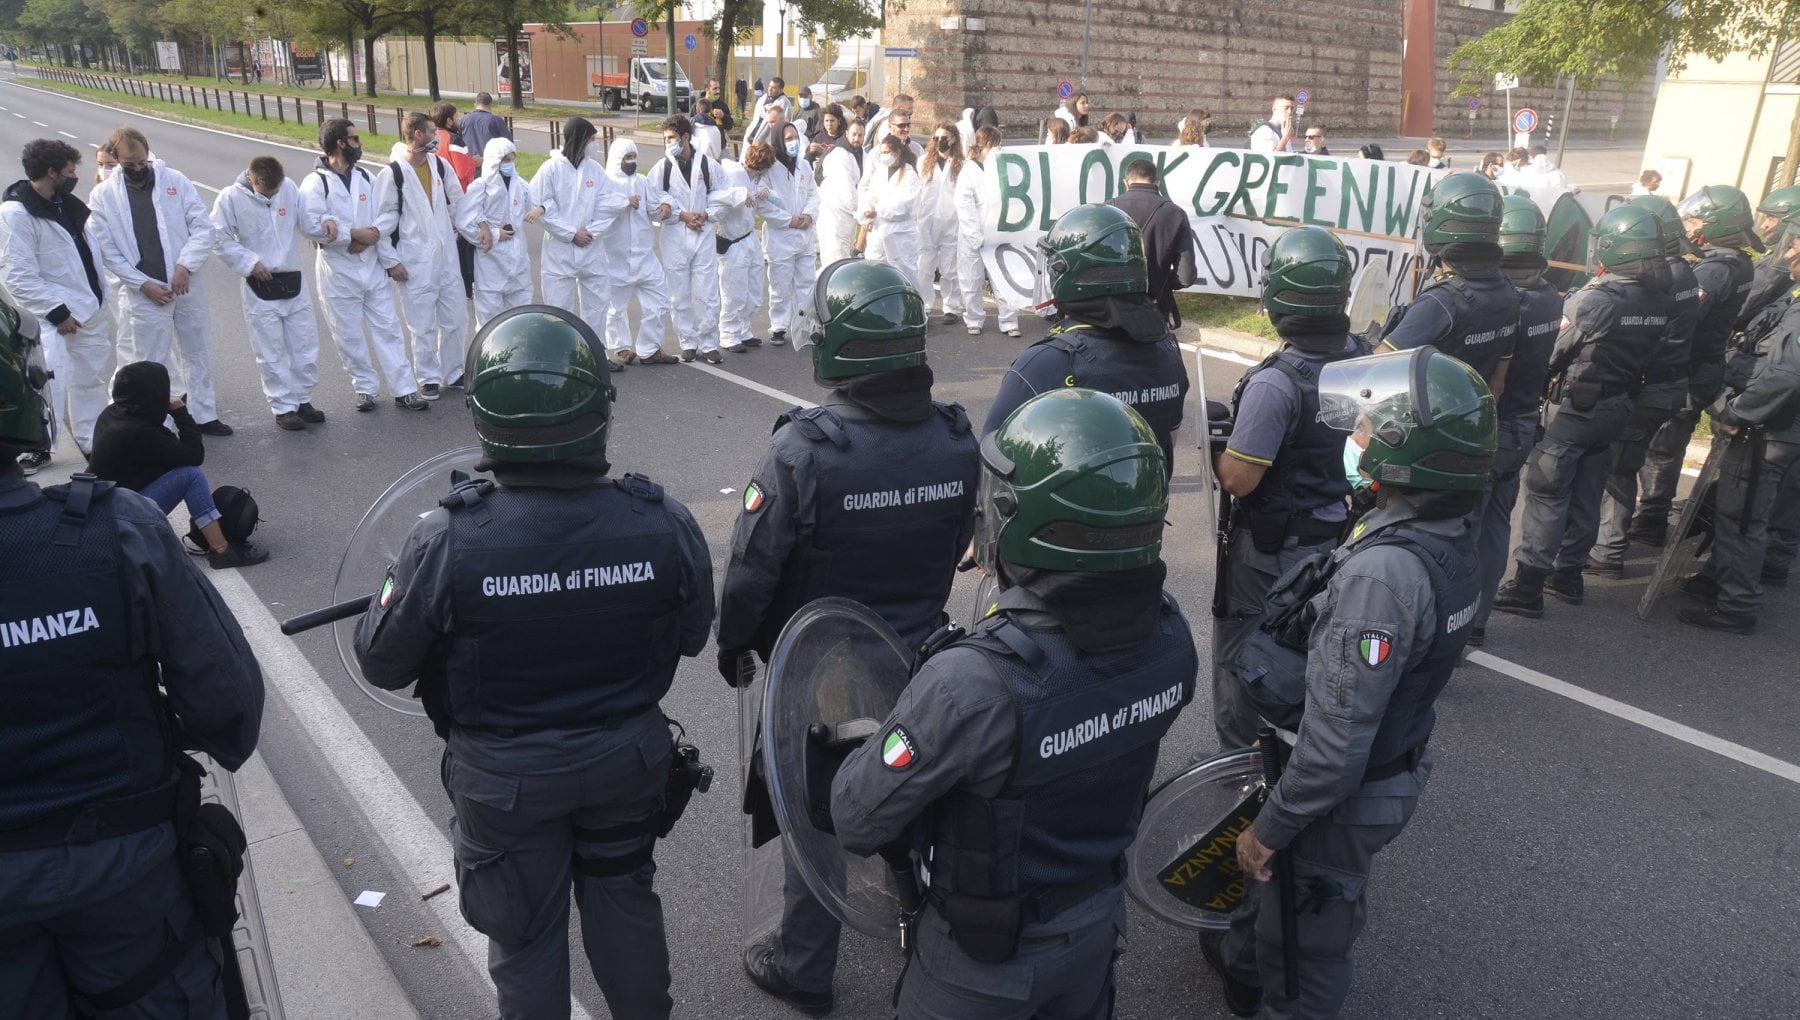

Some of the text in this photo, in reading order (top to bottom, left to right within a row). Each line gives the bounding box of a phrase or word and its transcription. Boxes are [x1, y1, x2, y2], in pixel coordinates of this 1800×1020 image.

[1192, 151, 1432, 240] GREENW
[1141, 389, 1150, 403] di
[1150, 383, 1180, 402] FINANZA
[843, 480, 964, 511] GUARDIA di FINANZA
[482, 561, 655, 597] GUARDIA di FINANZA
[0, 606, 100, 647] INANZA
[1363, 633, 1388, 643] ITALIA
[1039, 682, 1183, 759] GUARDIA di FINANZA
[1163, 816, 1252, 886] FINANZA
